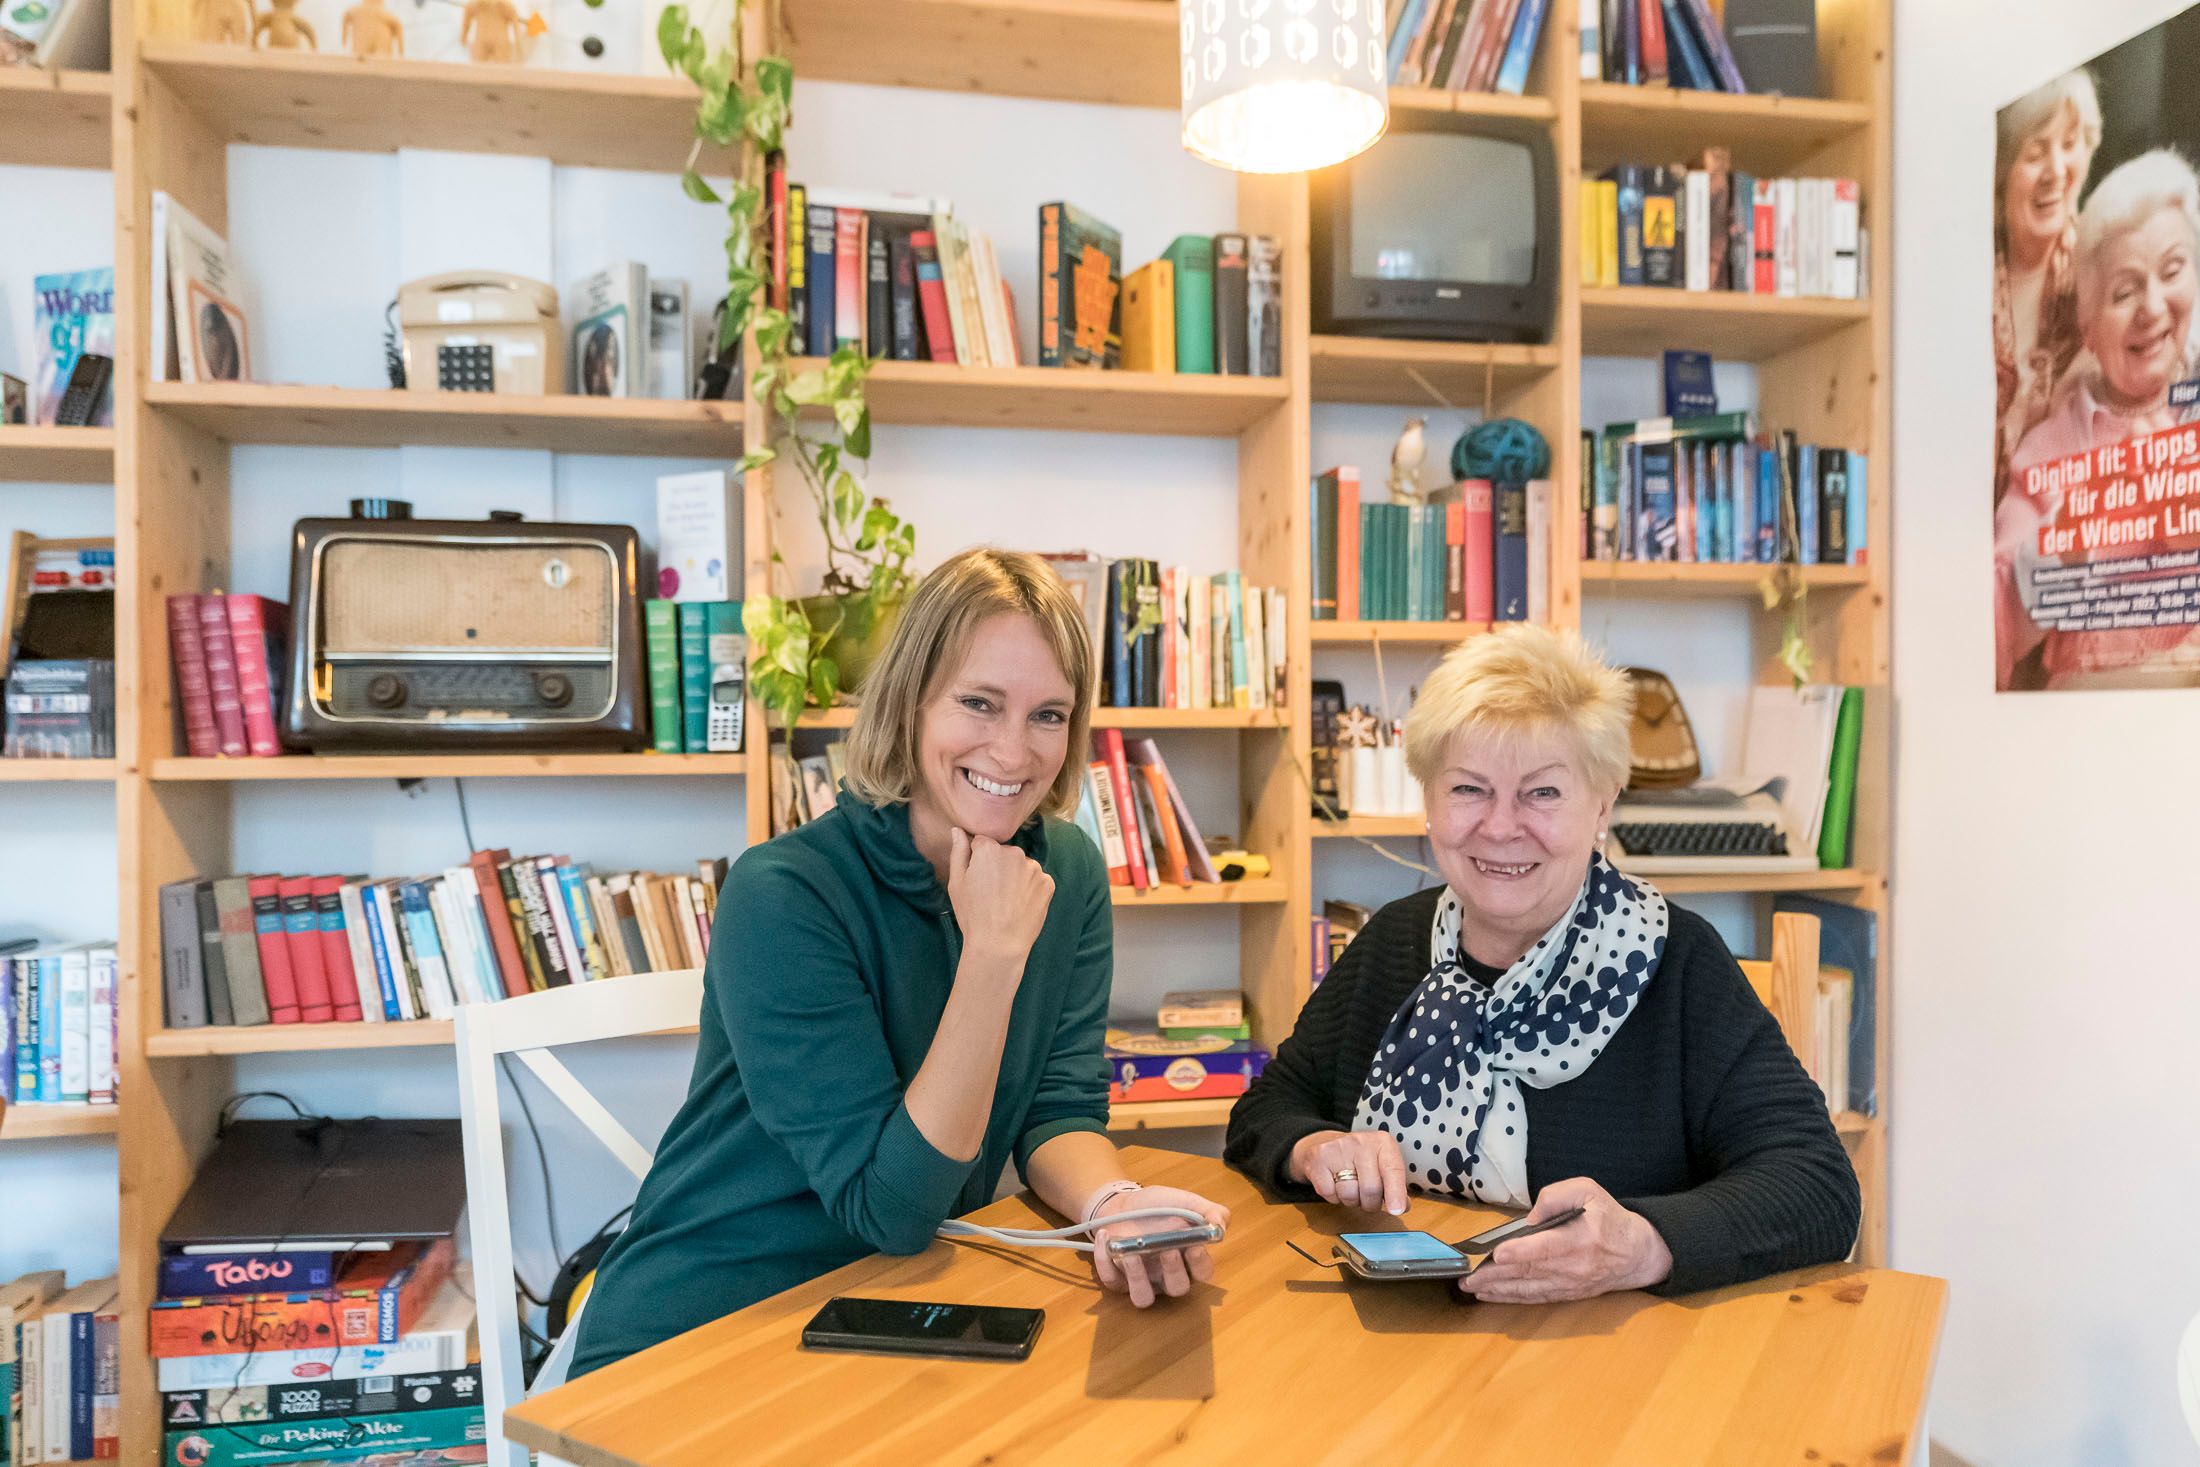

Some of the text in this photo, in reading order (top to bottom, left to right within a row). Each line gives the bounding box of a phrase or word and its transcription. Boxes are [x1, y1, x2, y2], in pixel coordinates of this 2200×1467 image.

[2027, 429, 2197, 497] Digital fit: Tipps
[2069, 486, 2099, 518] für
[2104, 478, 2138, 511] die
[2043, 527, 2077, 554] der
[2080, 515, 2158, 549] Wiener
[204, 1258, 293, 1288] Tabu
[381, 1292, 395, 1342] KOSMOS
[280, 1400, 321, 1414] PUZZLE
[281, 1389, 321, 1403] 1000
